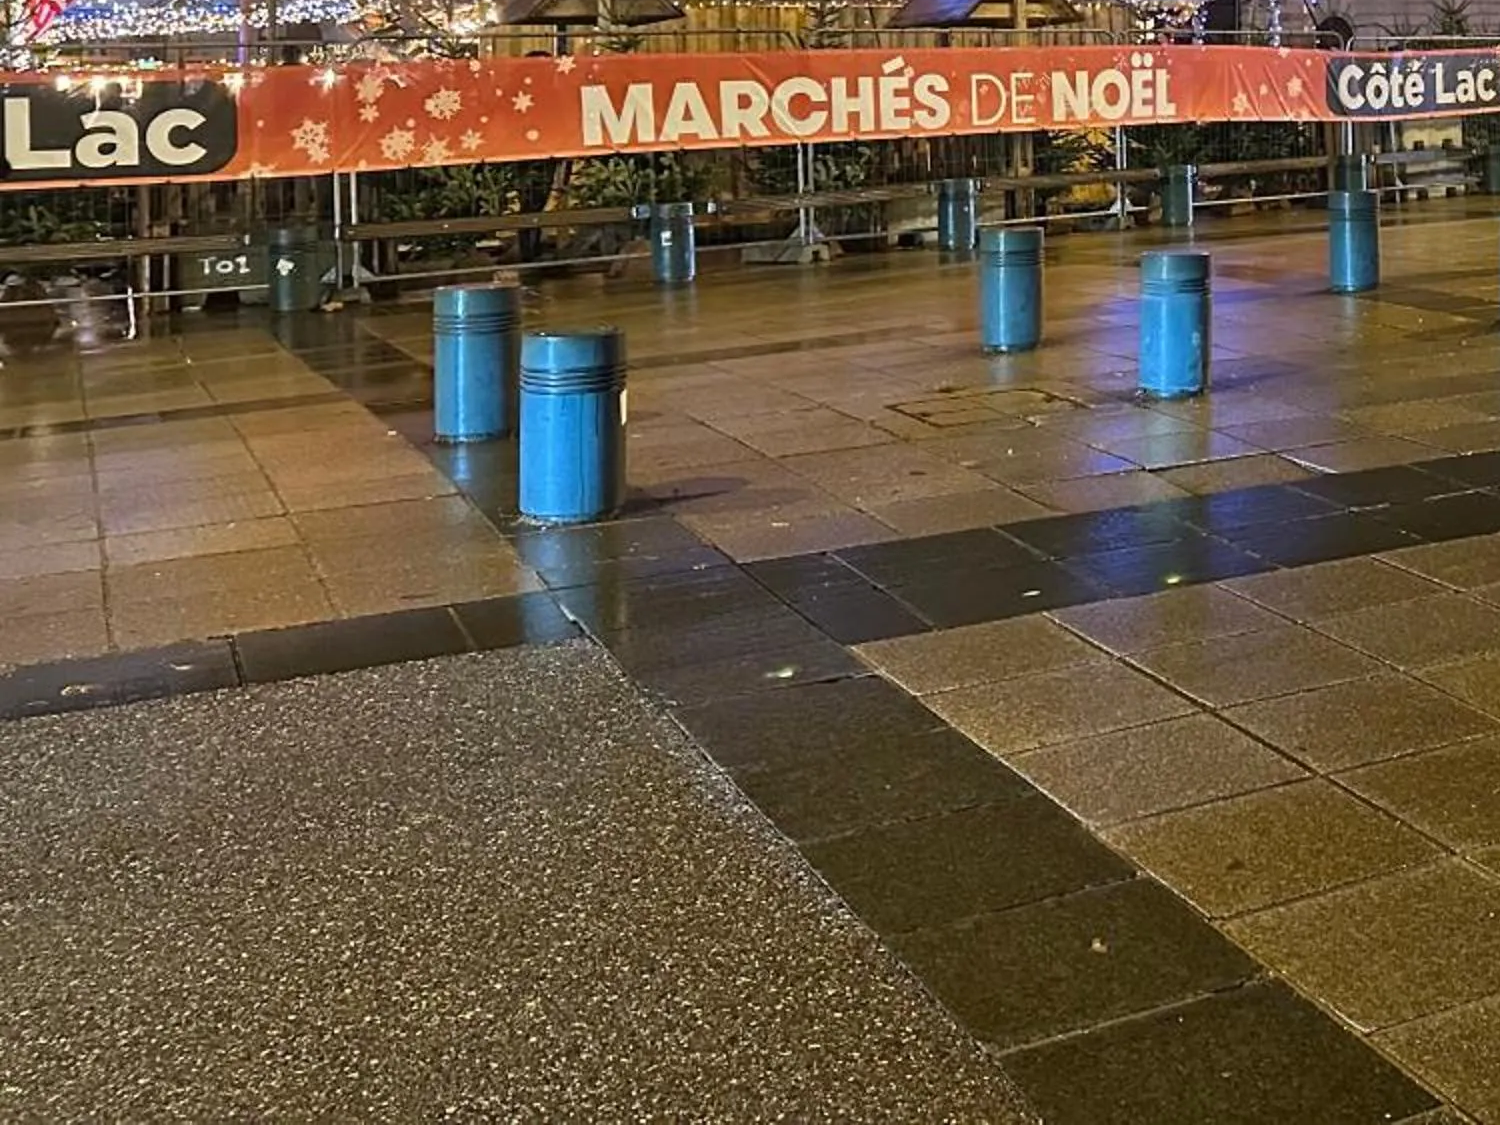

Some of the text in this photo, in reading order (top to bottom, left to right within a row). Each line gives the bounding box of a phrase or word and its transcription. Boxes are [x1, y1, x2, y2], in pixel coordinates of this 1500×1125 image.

[580, 52, 1177, 146] MARCHÉS DE NOËL
[1338, 59, 1497, 110] Côté Lac
[4, 97, 208, 170] Lac
